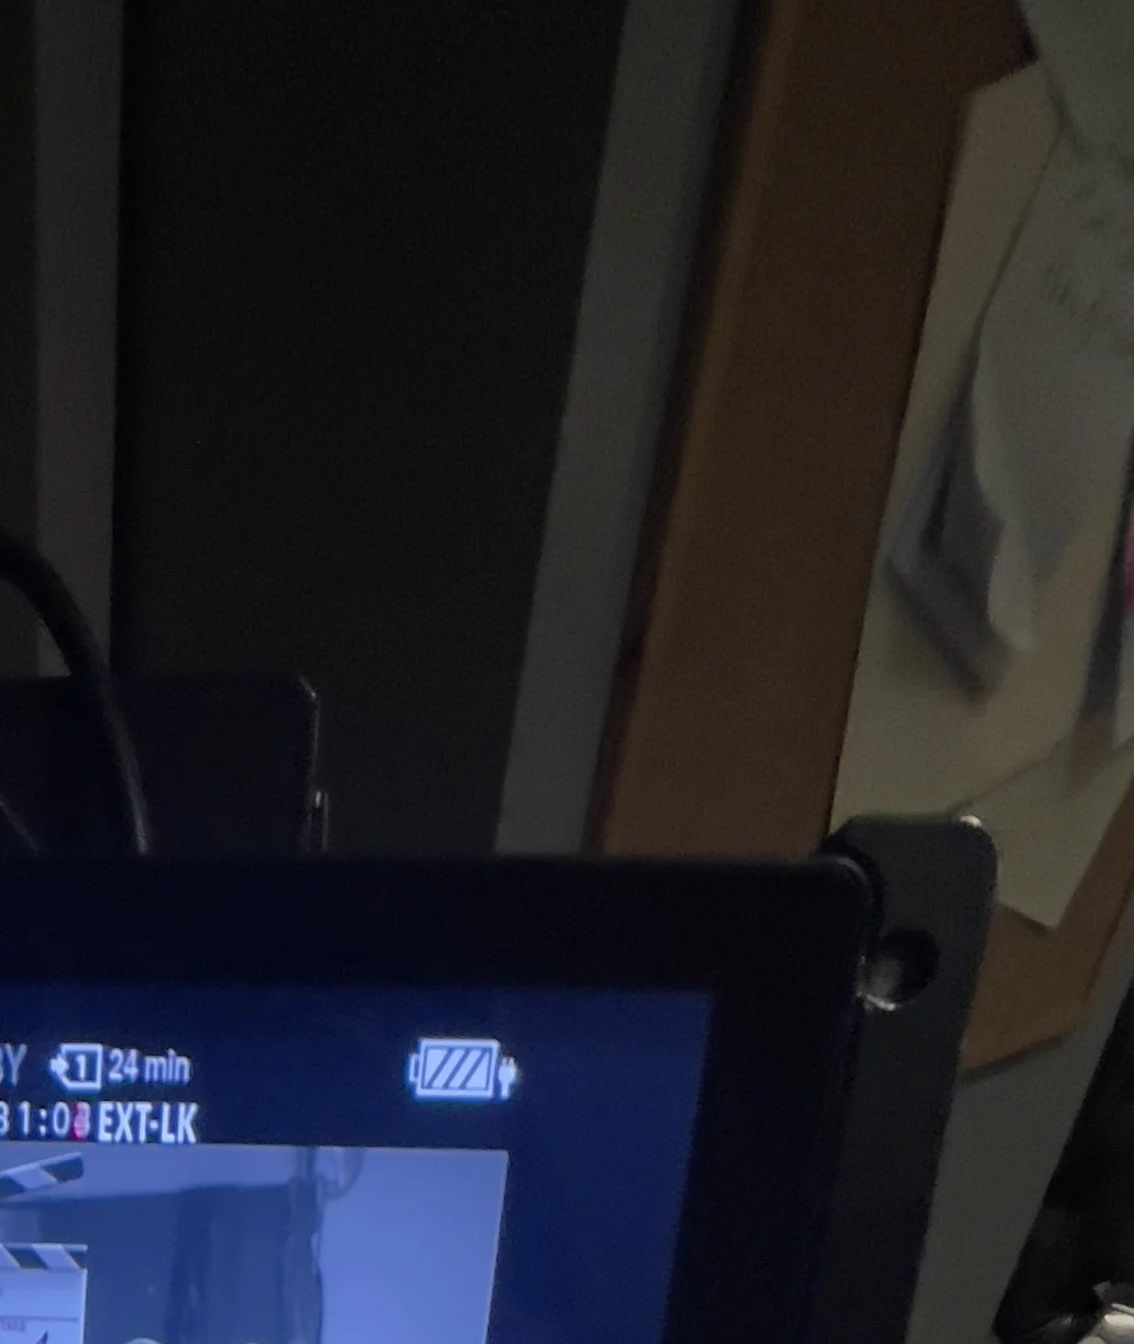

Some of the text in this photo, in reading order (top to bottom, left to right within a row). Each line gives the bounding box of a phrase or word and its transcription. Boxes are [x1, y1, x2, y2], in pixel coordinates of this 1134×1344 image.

[108, 1050, 191, 1083] 24 min
[98, 1101, 199, 1143] EXT-LK
